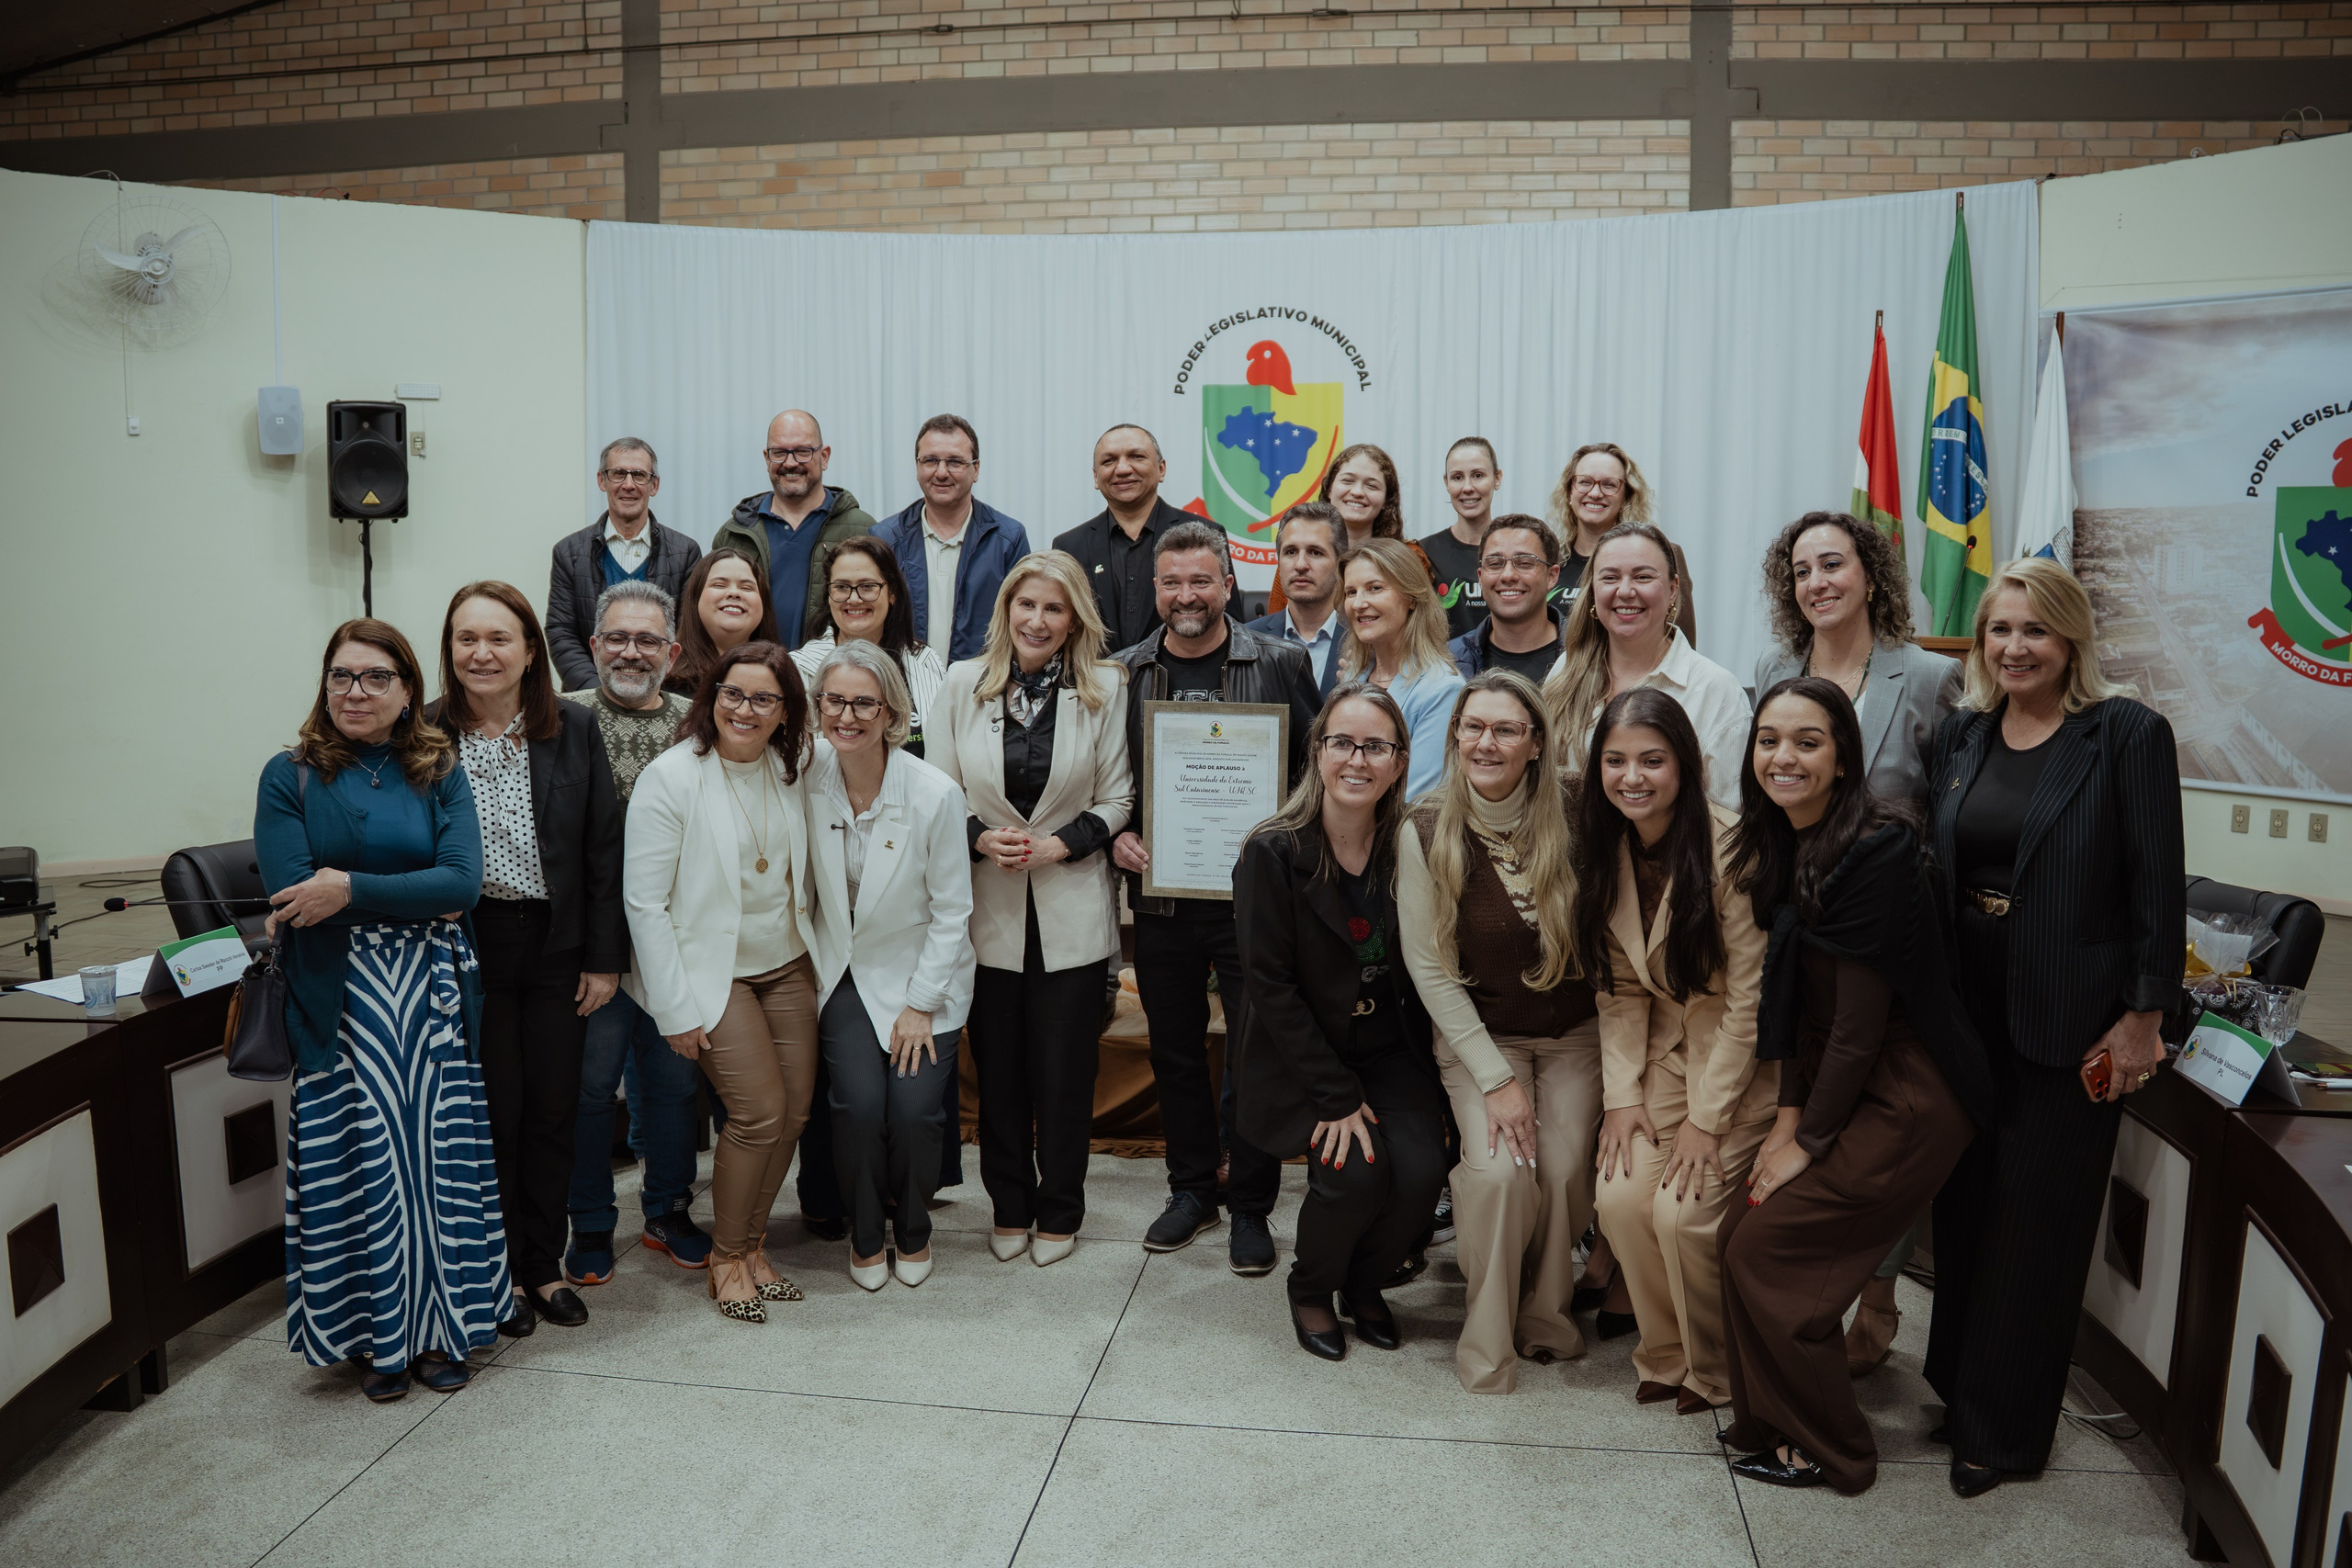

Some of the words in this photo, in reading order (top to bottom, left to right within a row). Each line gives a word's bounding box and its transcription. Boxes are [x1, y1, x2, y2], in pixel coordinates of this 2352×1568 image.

[1174, 341, 1206, 395] PODER
[1204, 306, 1308, 342] LEGISLATIVO
[1310, 315, 1372, 392] MUNICIPAL
[2246, 438, 2284, 498] PODER
[1247, 550, 1265, 561] DA
[2271, 641, 2318, 675] MORRO
[2320, 669, 2340, 682] DA
[1180, 774, 1218, 783] Universidade
[1228, 776, 1252, 784] Extremo
[1186, 785, 1219, 793] Catarinense
[1229, 786, 1257, 795] UNESC
[2201, 1048, 2217, 1062] Silvana
[2224, 1059, 2252, 1080] Vasconcelos
[2217, 1068, 2223, 1077] PL
